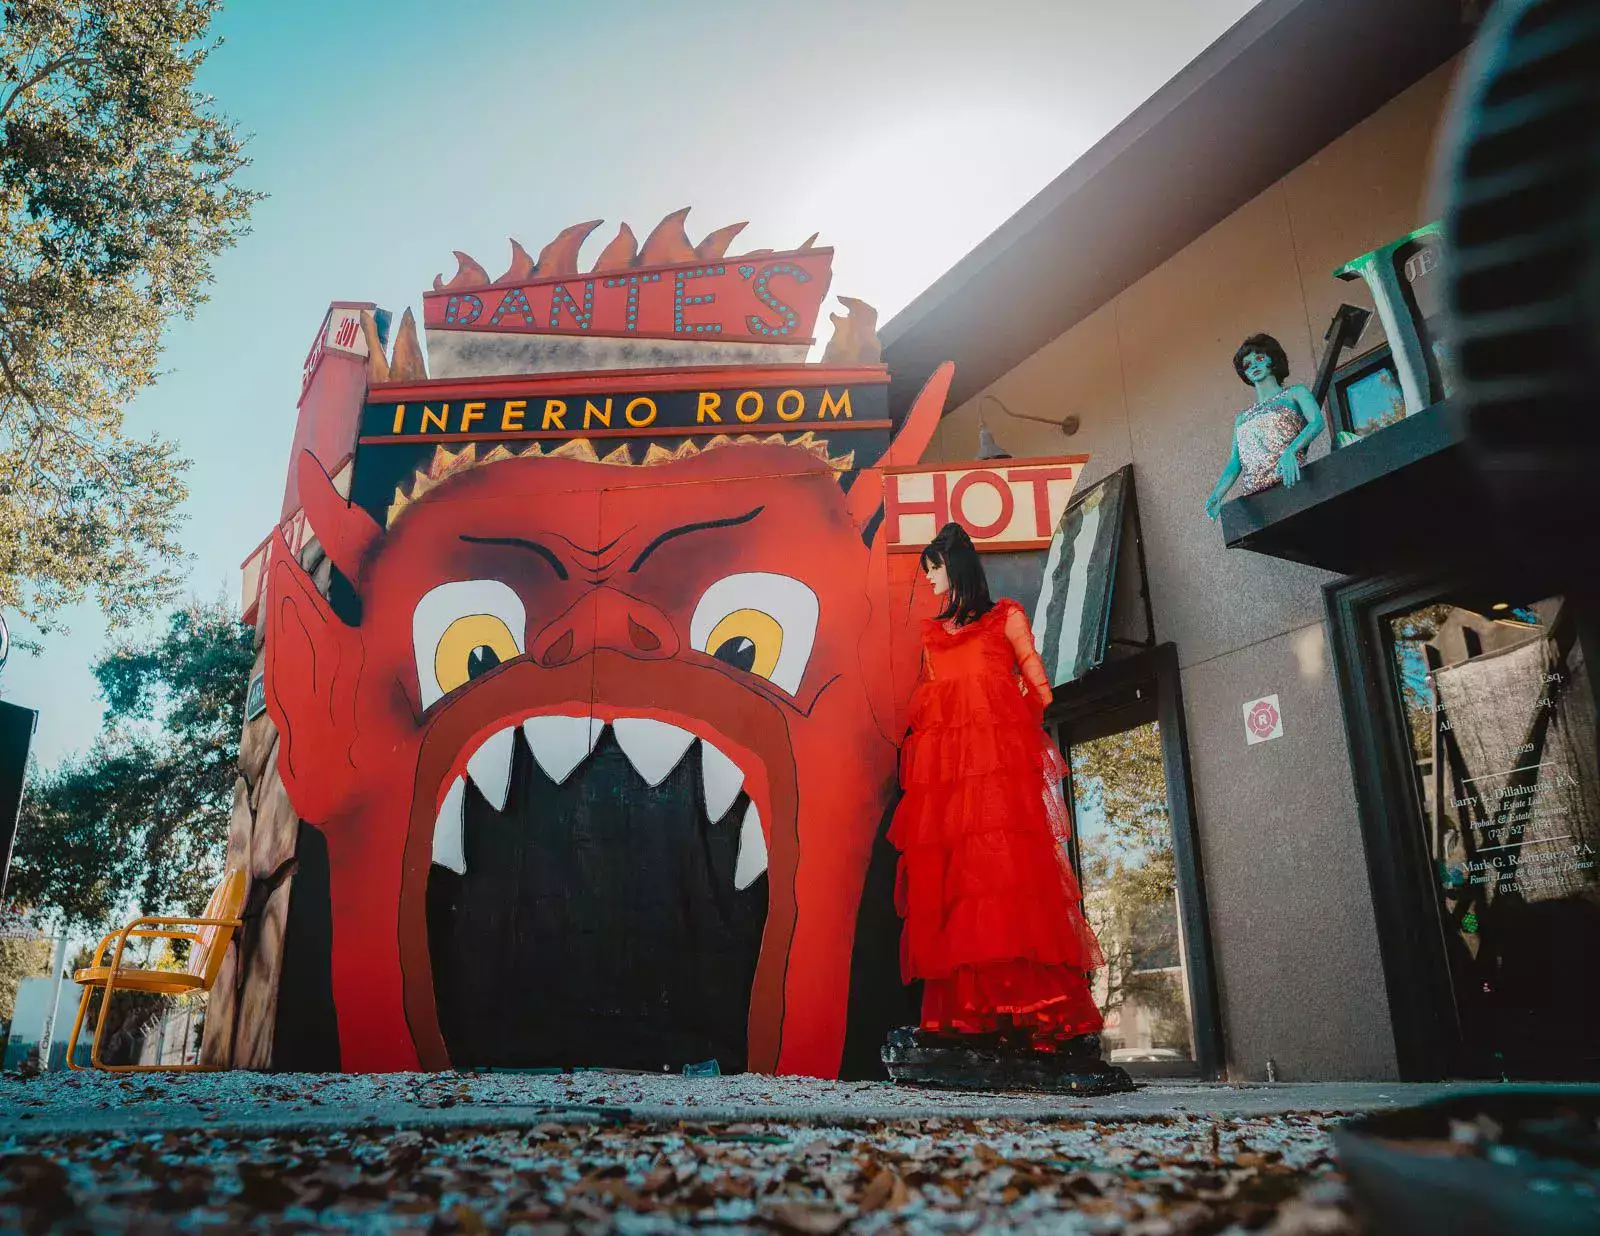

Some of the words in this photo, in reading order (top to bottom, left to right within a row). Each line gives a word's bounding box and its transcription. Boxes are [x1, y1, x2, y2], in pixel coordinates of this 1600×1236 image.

[445, 262, 812, 337] DANTE'S
[392, 397, 658, 434] INFERNO
[696, 389, 852, 423] ROOM
[886, 467, 1073, 544] HOT
[1450, 796, 1478, 808] Larry
[1503, 800, 1526, 811] Estate
[1470, 818, 1496, 830] Probate
[1498, 815, 1507, 824] &
[1509, 812, 1532, 822] Estate
[1462, 859, 1491, 873] Mark
[1492, 857, 1506, 868] G.
[1572, 844, 1596, 857] P.A.
[1497, 871, 1513, 881] Law
[1515, 868, 1525, 877] &
[1564, 860, 1594, 872] Defense
